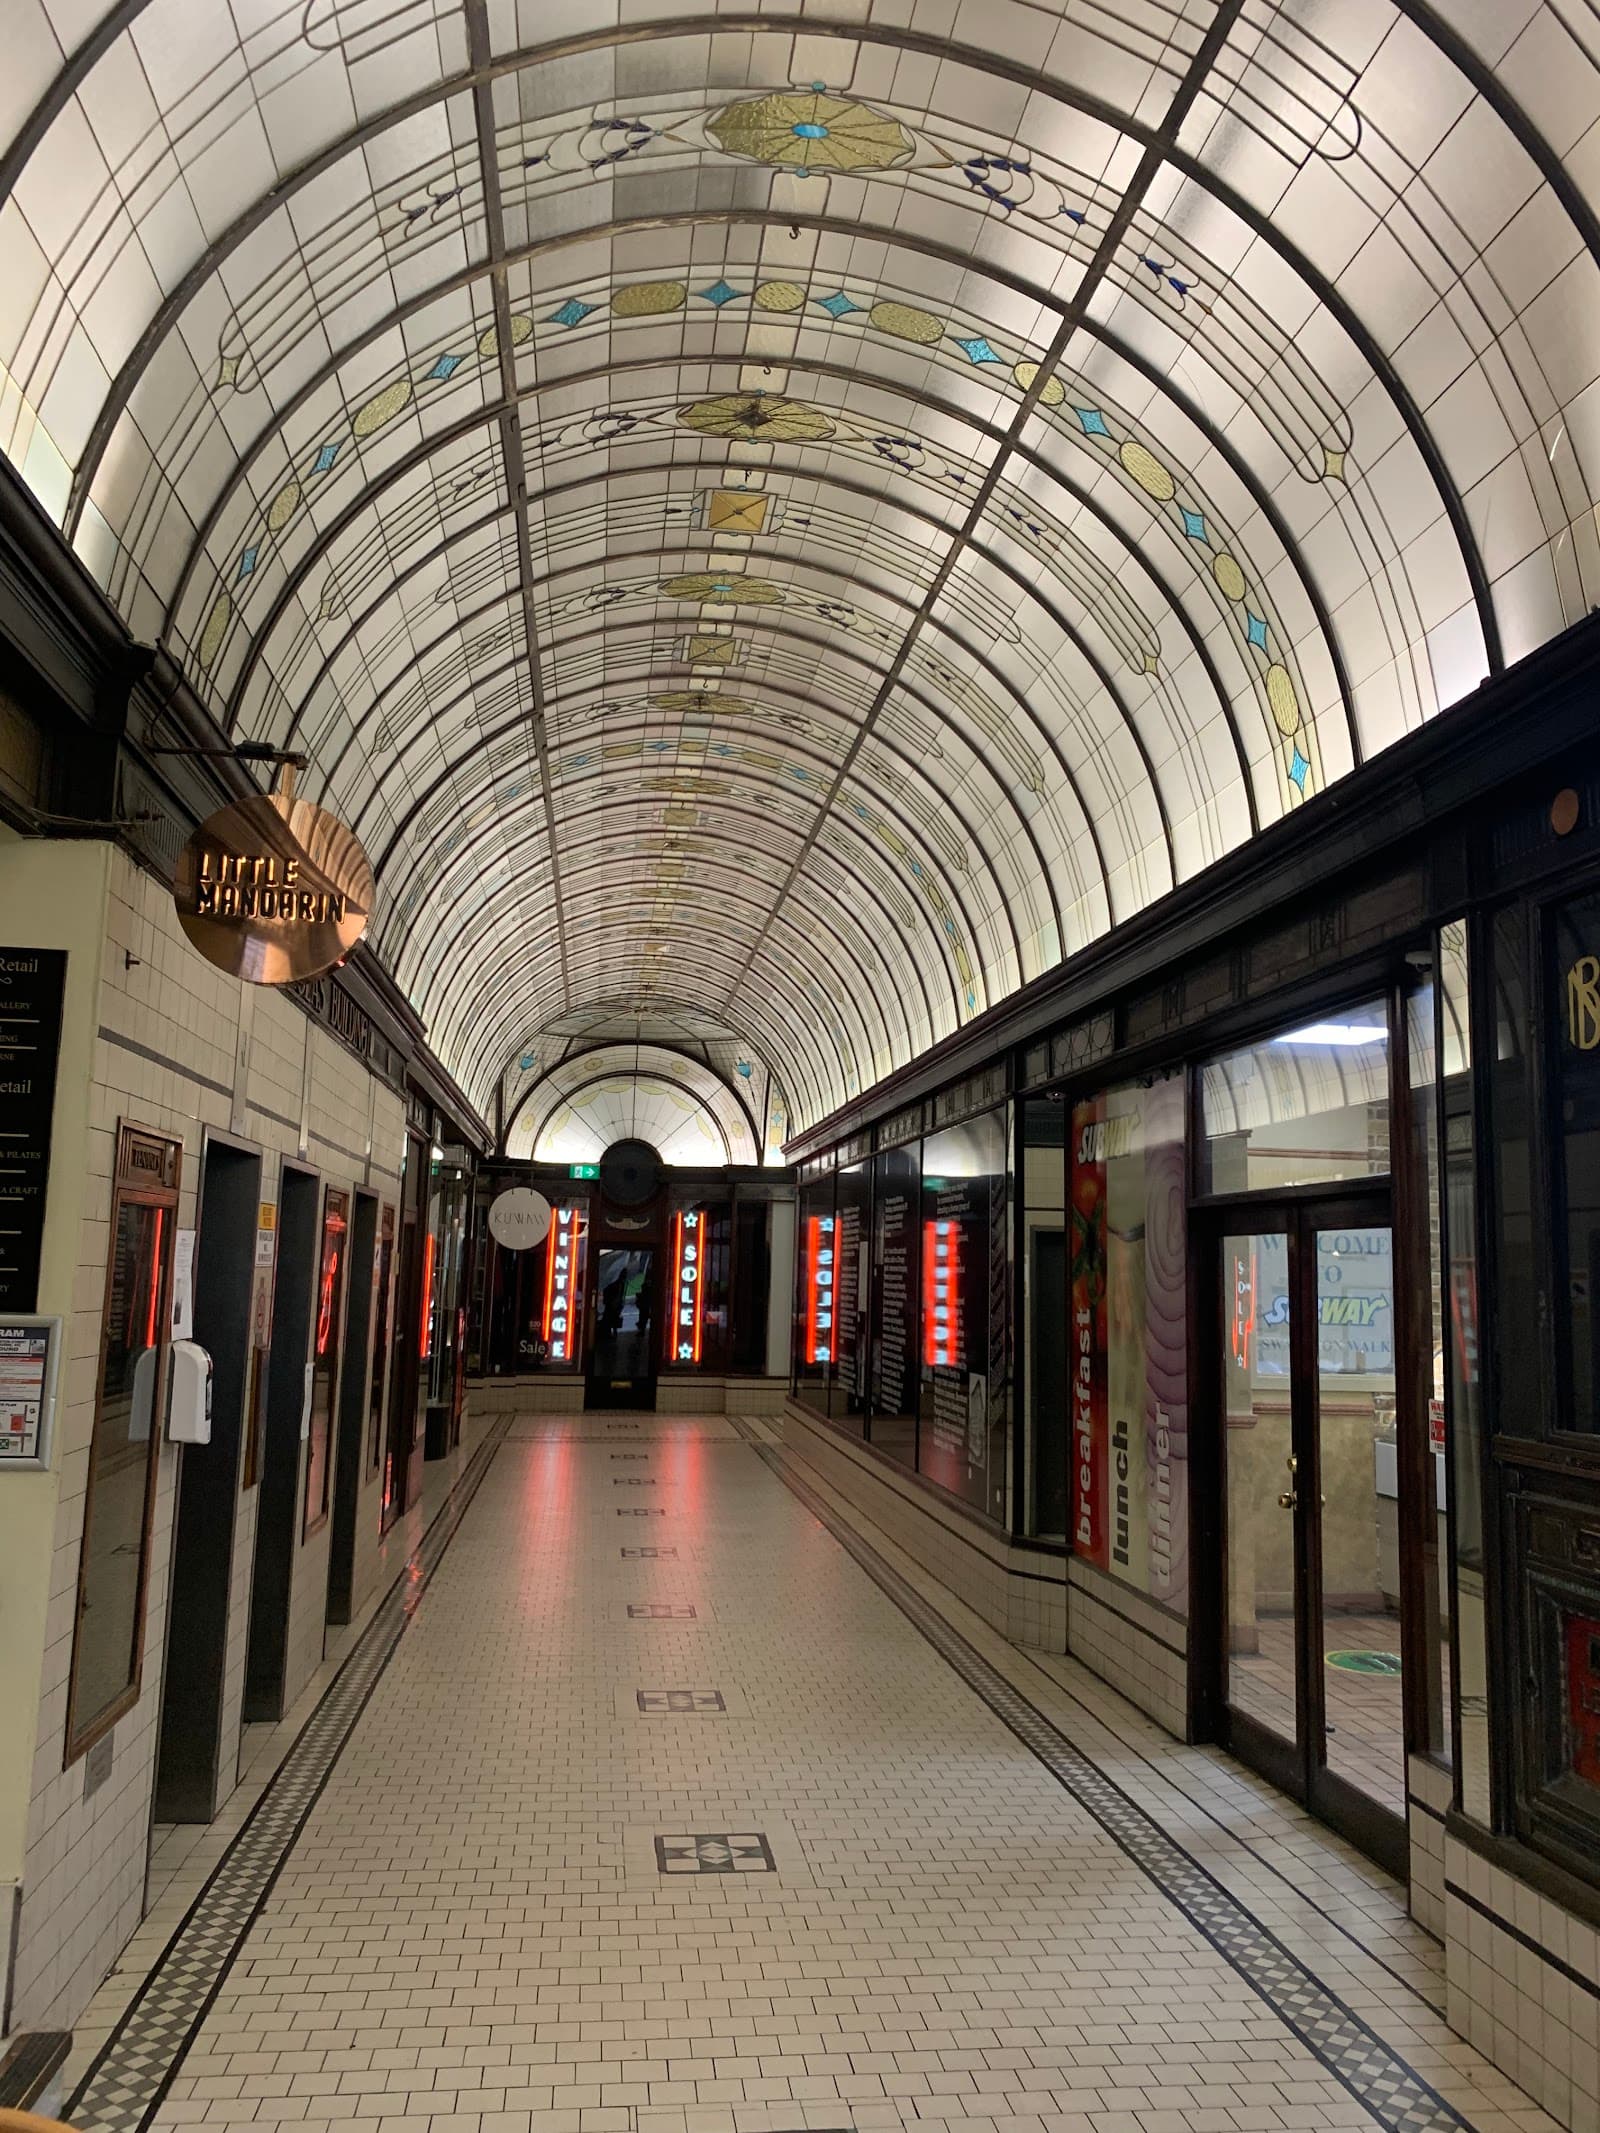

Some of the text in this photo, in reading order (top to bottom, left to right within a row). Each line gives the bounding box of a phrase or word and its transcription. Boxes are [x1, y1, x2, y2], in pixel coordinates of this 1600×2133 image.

[197, 852, 299, 889] LITTLE
[196, 882, 346, 925] MANDARIN
[1078, 1104, 1142, 1166] SUBWAY
[1262, 1236, 1389, 1255] WCOME
[550, 1210, 573, 1359] VINTAGE
[680, 1244, 698, 1326] SOLE
[1262, 1293, 1390, 1328] SWAY
[519, 1340, 546, 1355] Sale
[1076, 1307, 1092, 1547] breakfast
[1112, 1420, 1129, 1566] lunch
[1152, 1400, 1171, 1588] dinner
